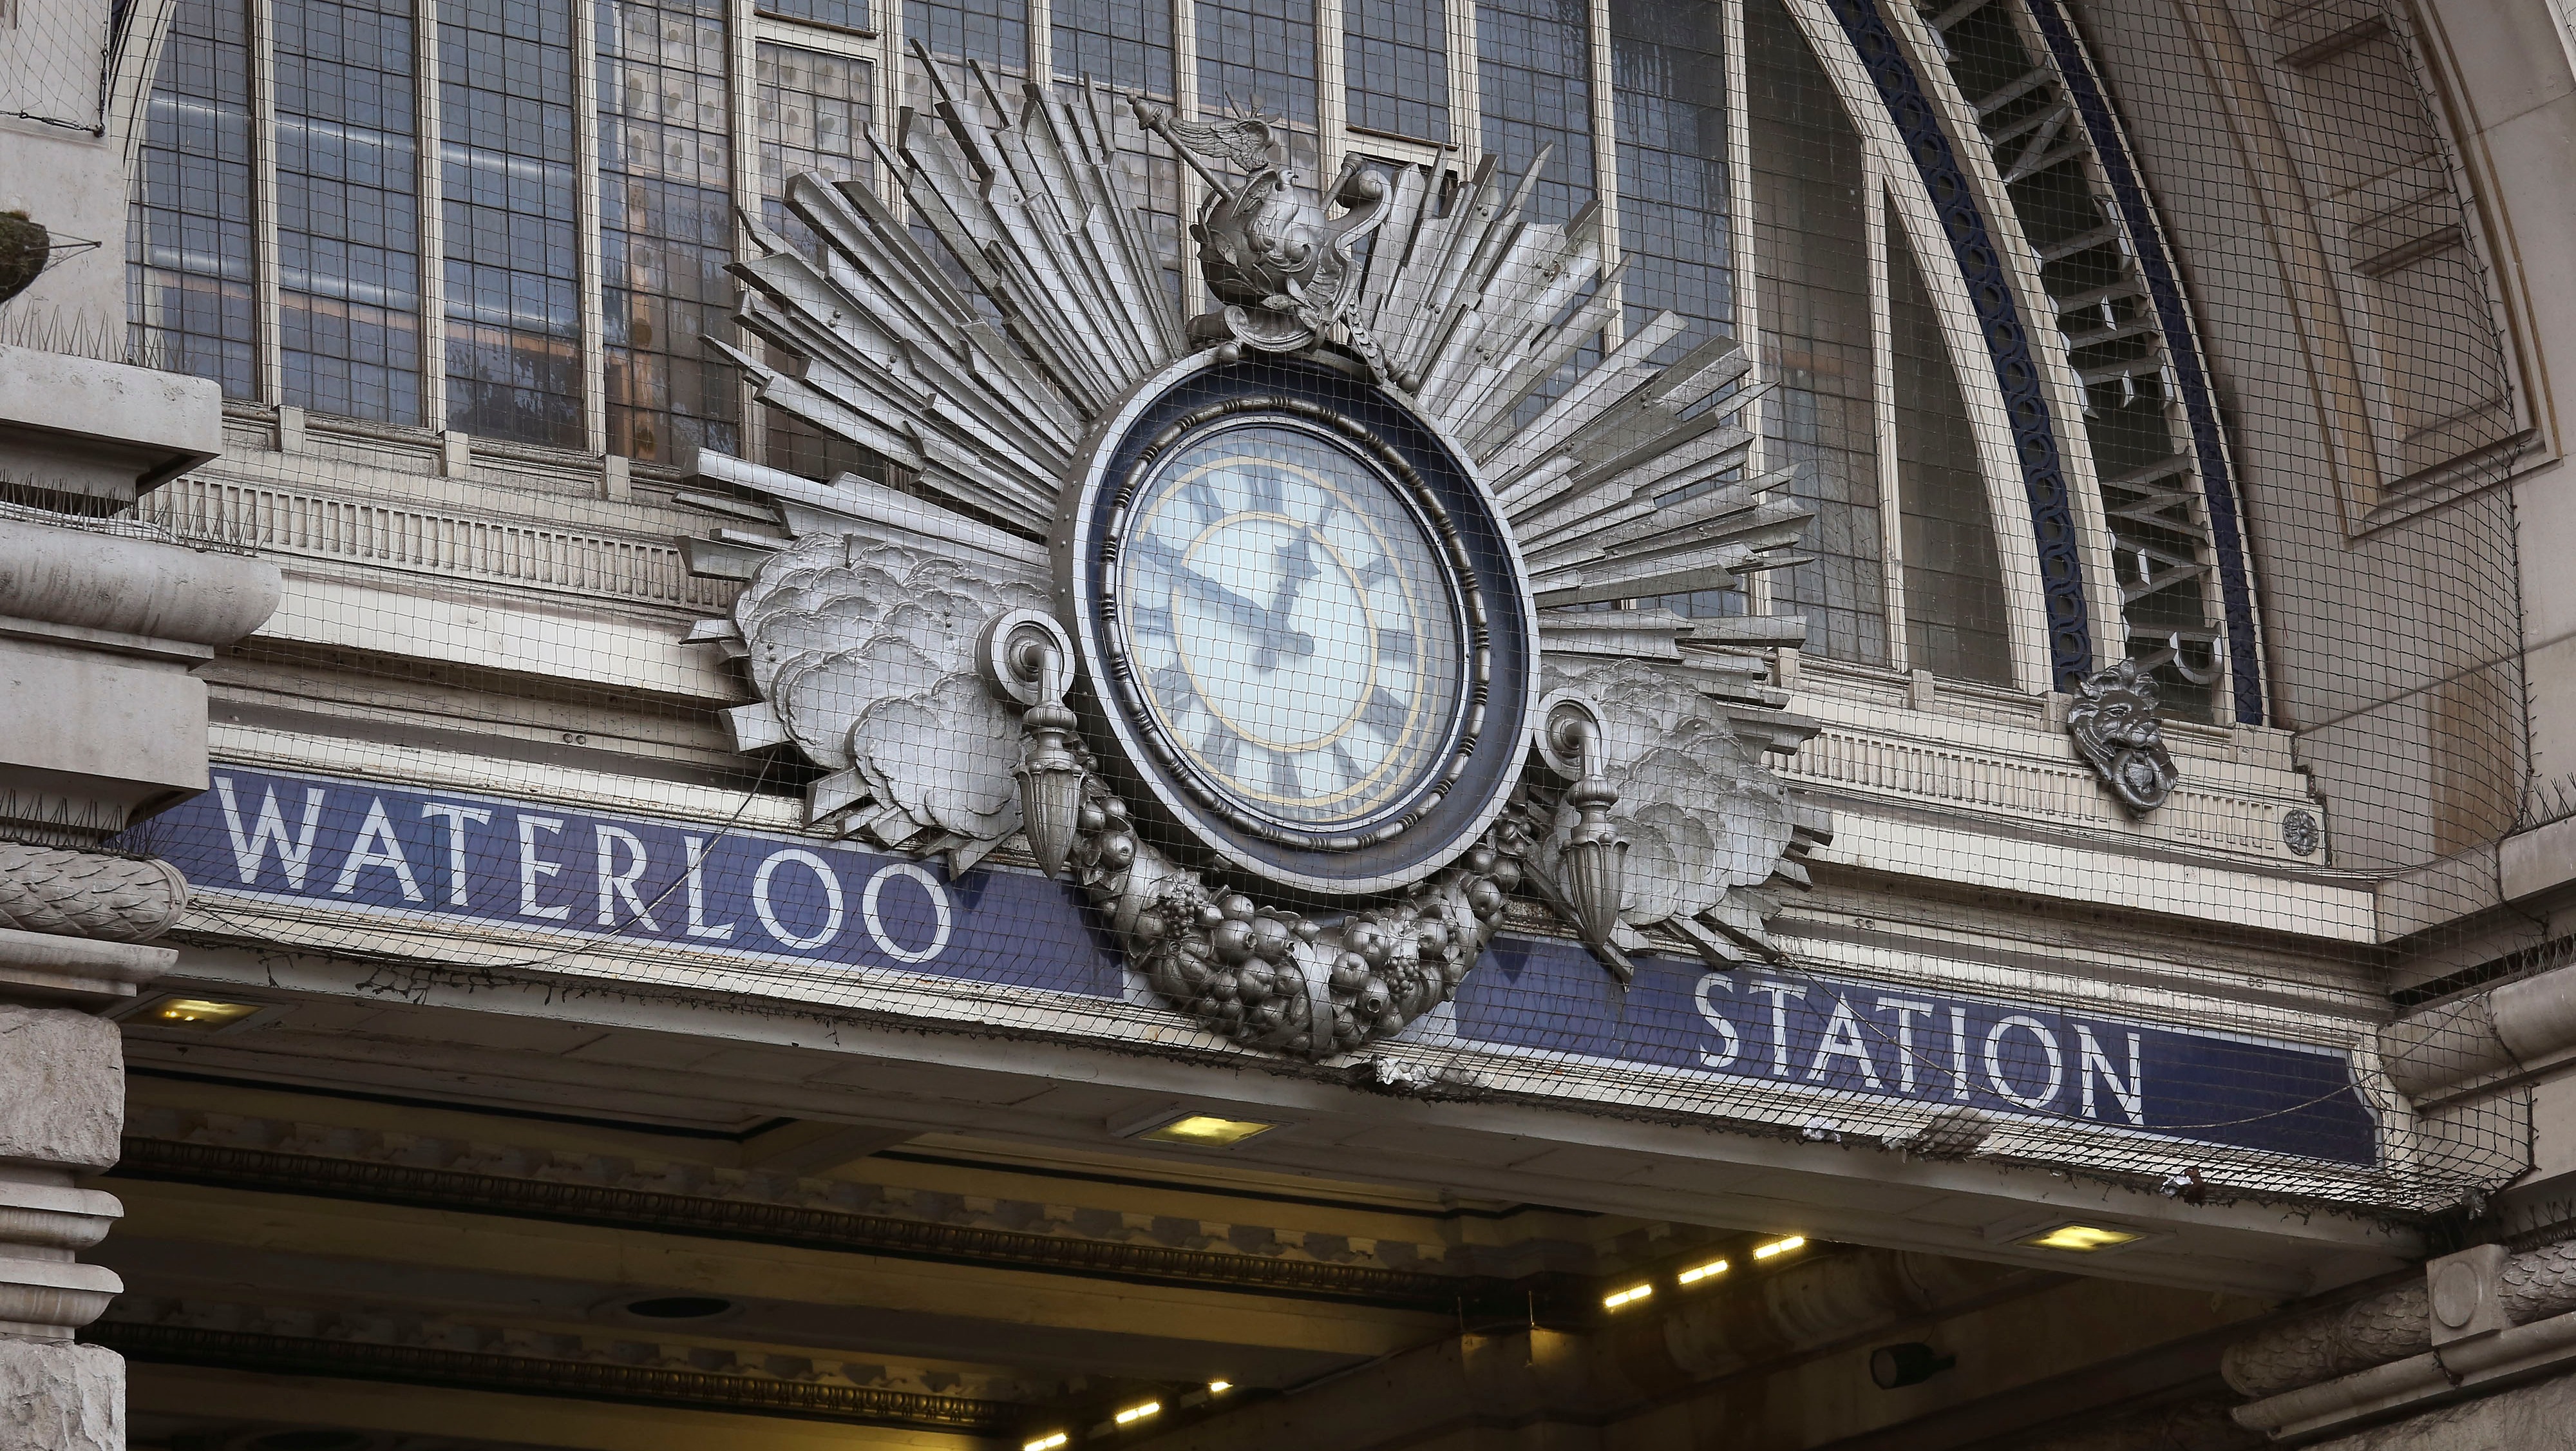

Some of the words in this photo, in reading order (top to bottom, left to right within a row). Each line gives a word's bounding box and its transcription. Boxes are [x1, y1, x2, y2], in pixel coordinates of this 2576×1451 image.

[1964, 50, 2092, 186] IN
[2029, 194, 2175, 418] THE
[2100, 445, 2224, 685] WAR
[214, 775, 951, 963] WATERLOO
[1694, 972, 2145, 1125] STATION
